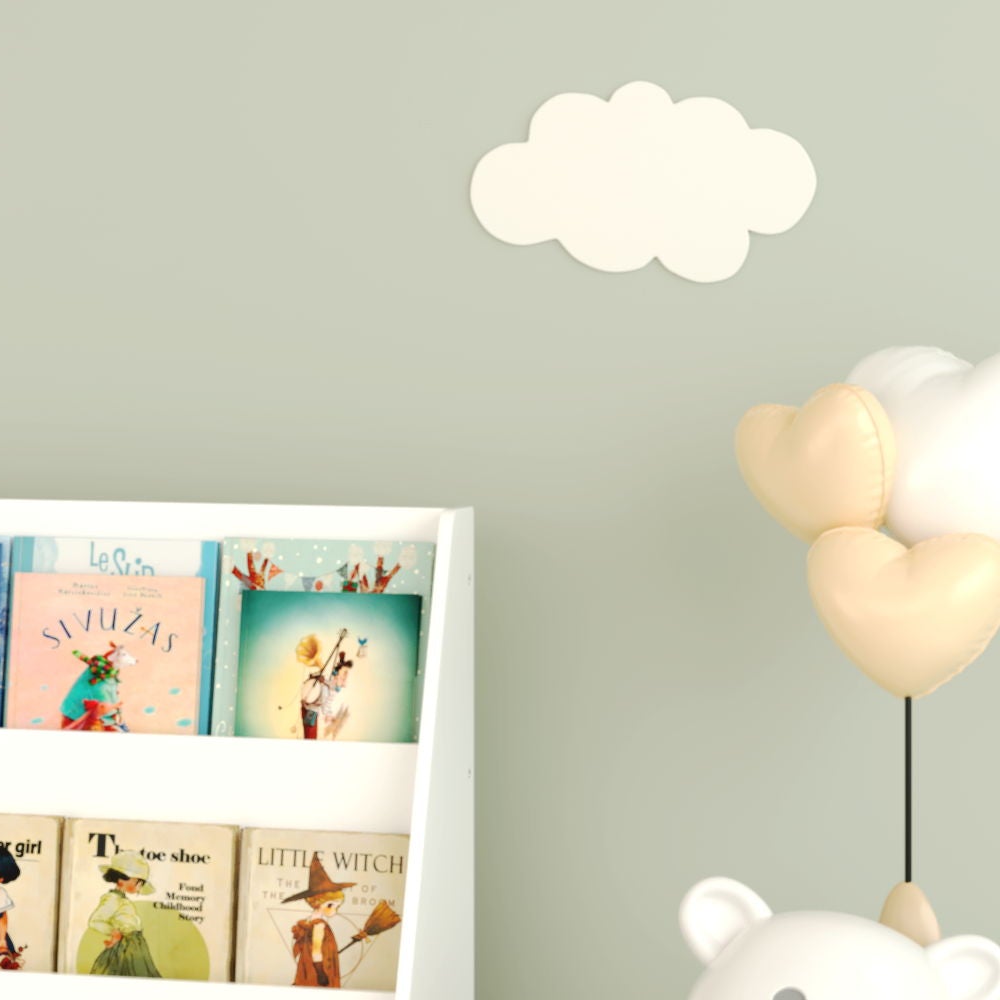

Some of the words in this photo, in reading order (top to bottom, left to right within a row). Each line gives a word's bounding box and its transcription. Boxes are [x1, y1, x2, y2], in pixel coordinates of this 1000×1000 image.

[90, 541, 109, 572] Le
[15, 839, 42, 858] girl
[170, 848, 211, 864] shoe
[333, 851, 404, 874] WITCH
[179, 883, 204, 892] Fond
[277, 878, 300, 889] THE
[361, 885, 377, 893] OF
[166, 891, 205, 903] Memory
[351, 896, 396, 907] BROM
[153, 901, 203, 912] Childhood
[178, 913, 205, 924] Story
